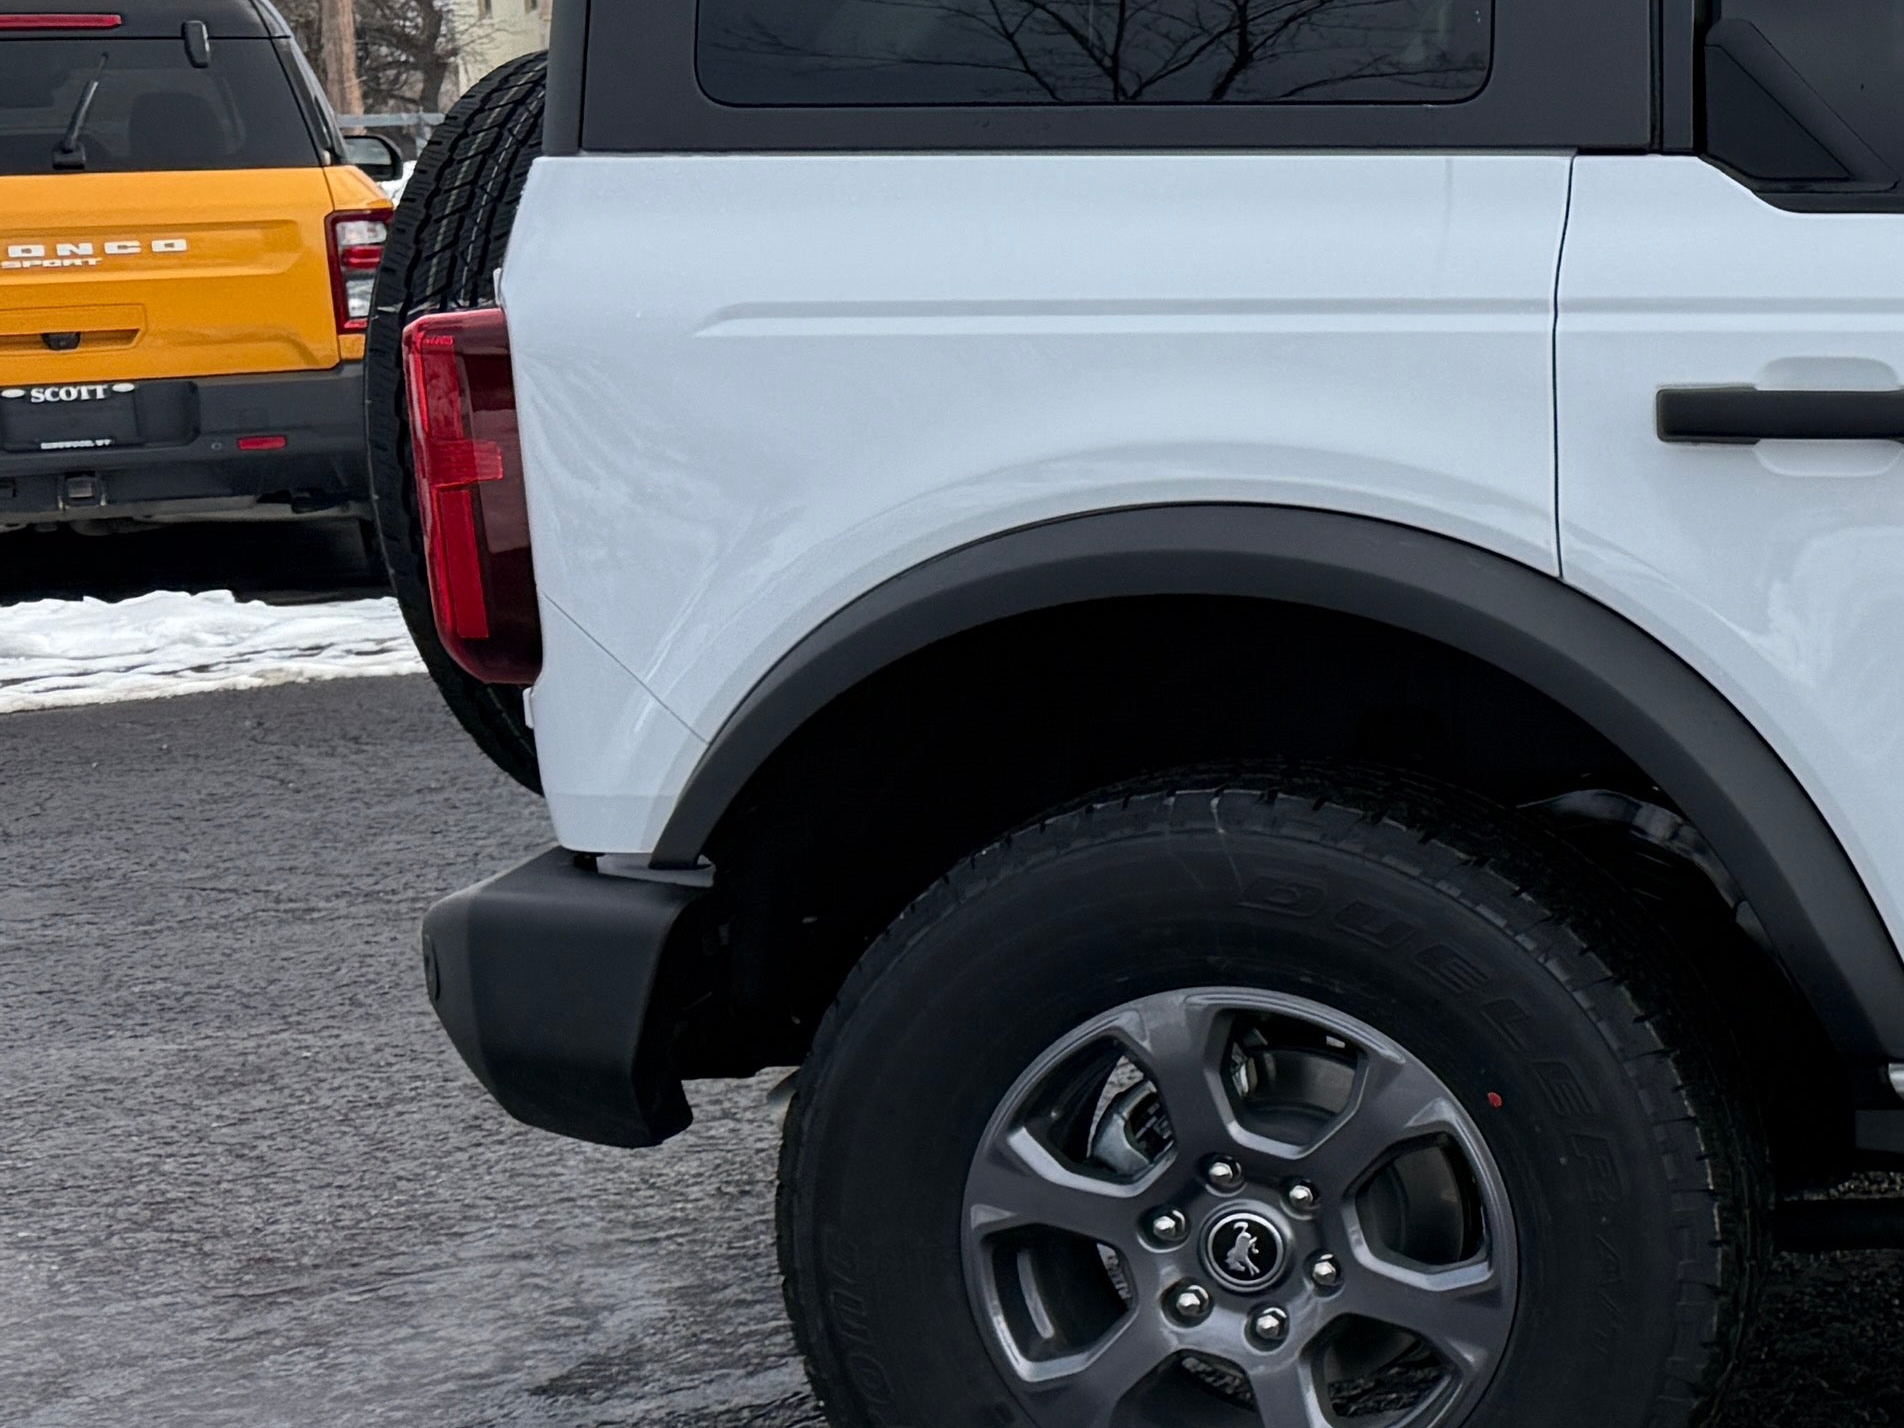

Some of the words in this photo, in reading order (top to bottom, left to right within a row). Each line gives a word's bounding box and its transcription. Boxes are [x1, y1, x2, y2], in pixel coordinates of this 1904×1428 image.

[1, 257, 102, 268] SPORT
[30, 384, 108, 403] SCOTT
[1233, 875, 1628, 1203] DUELER
